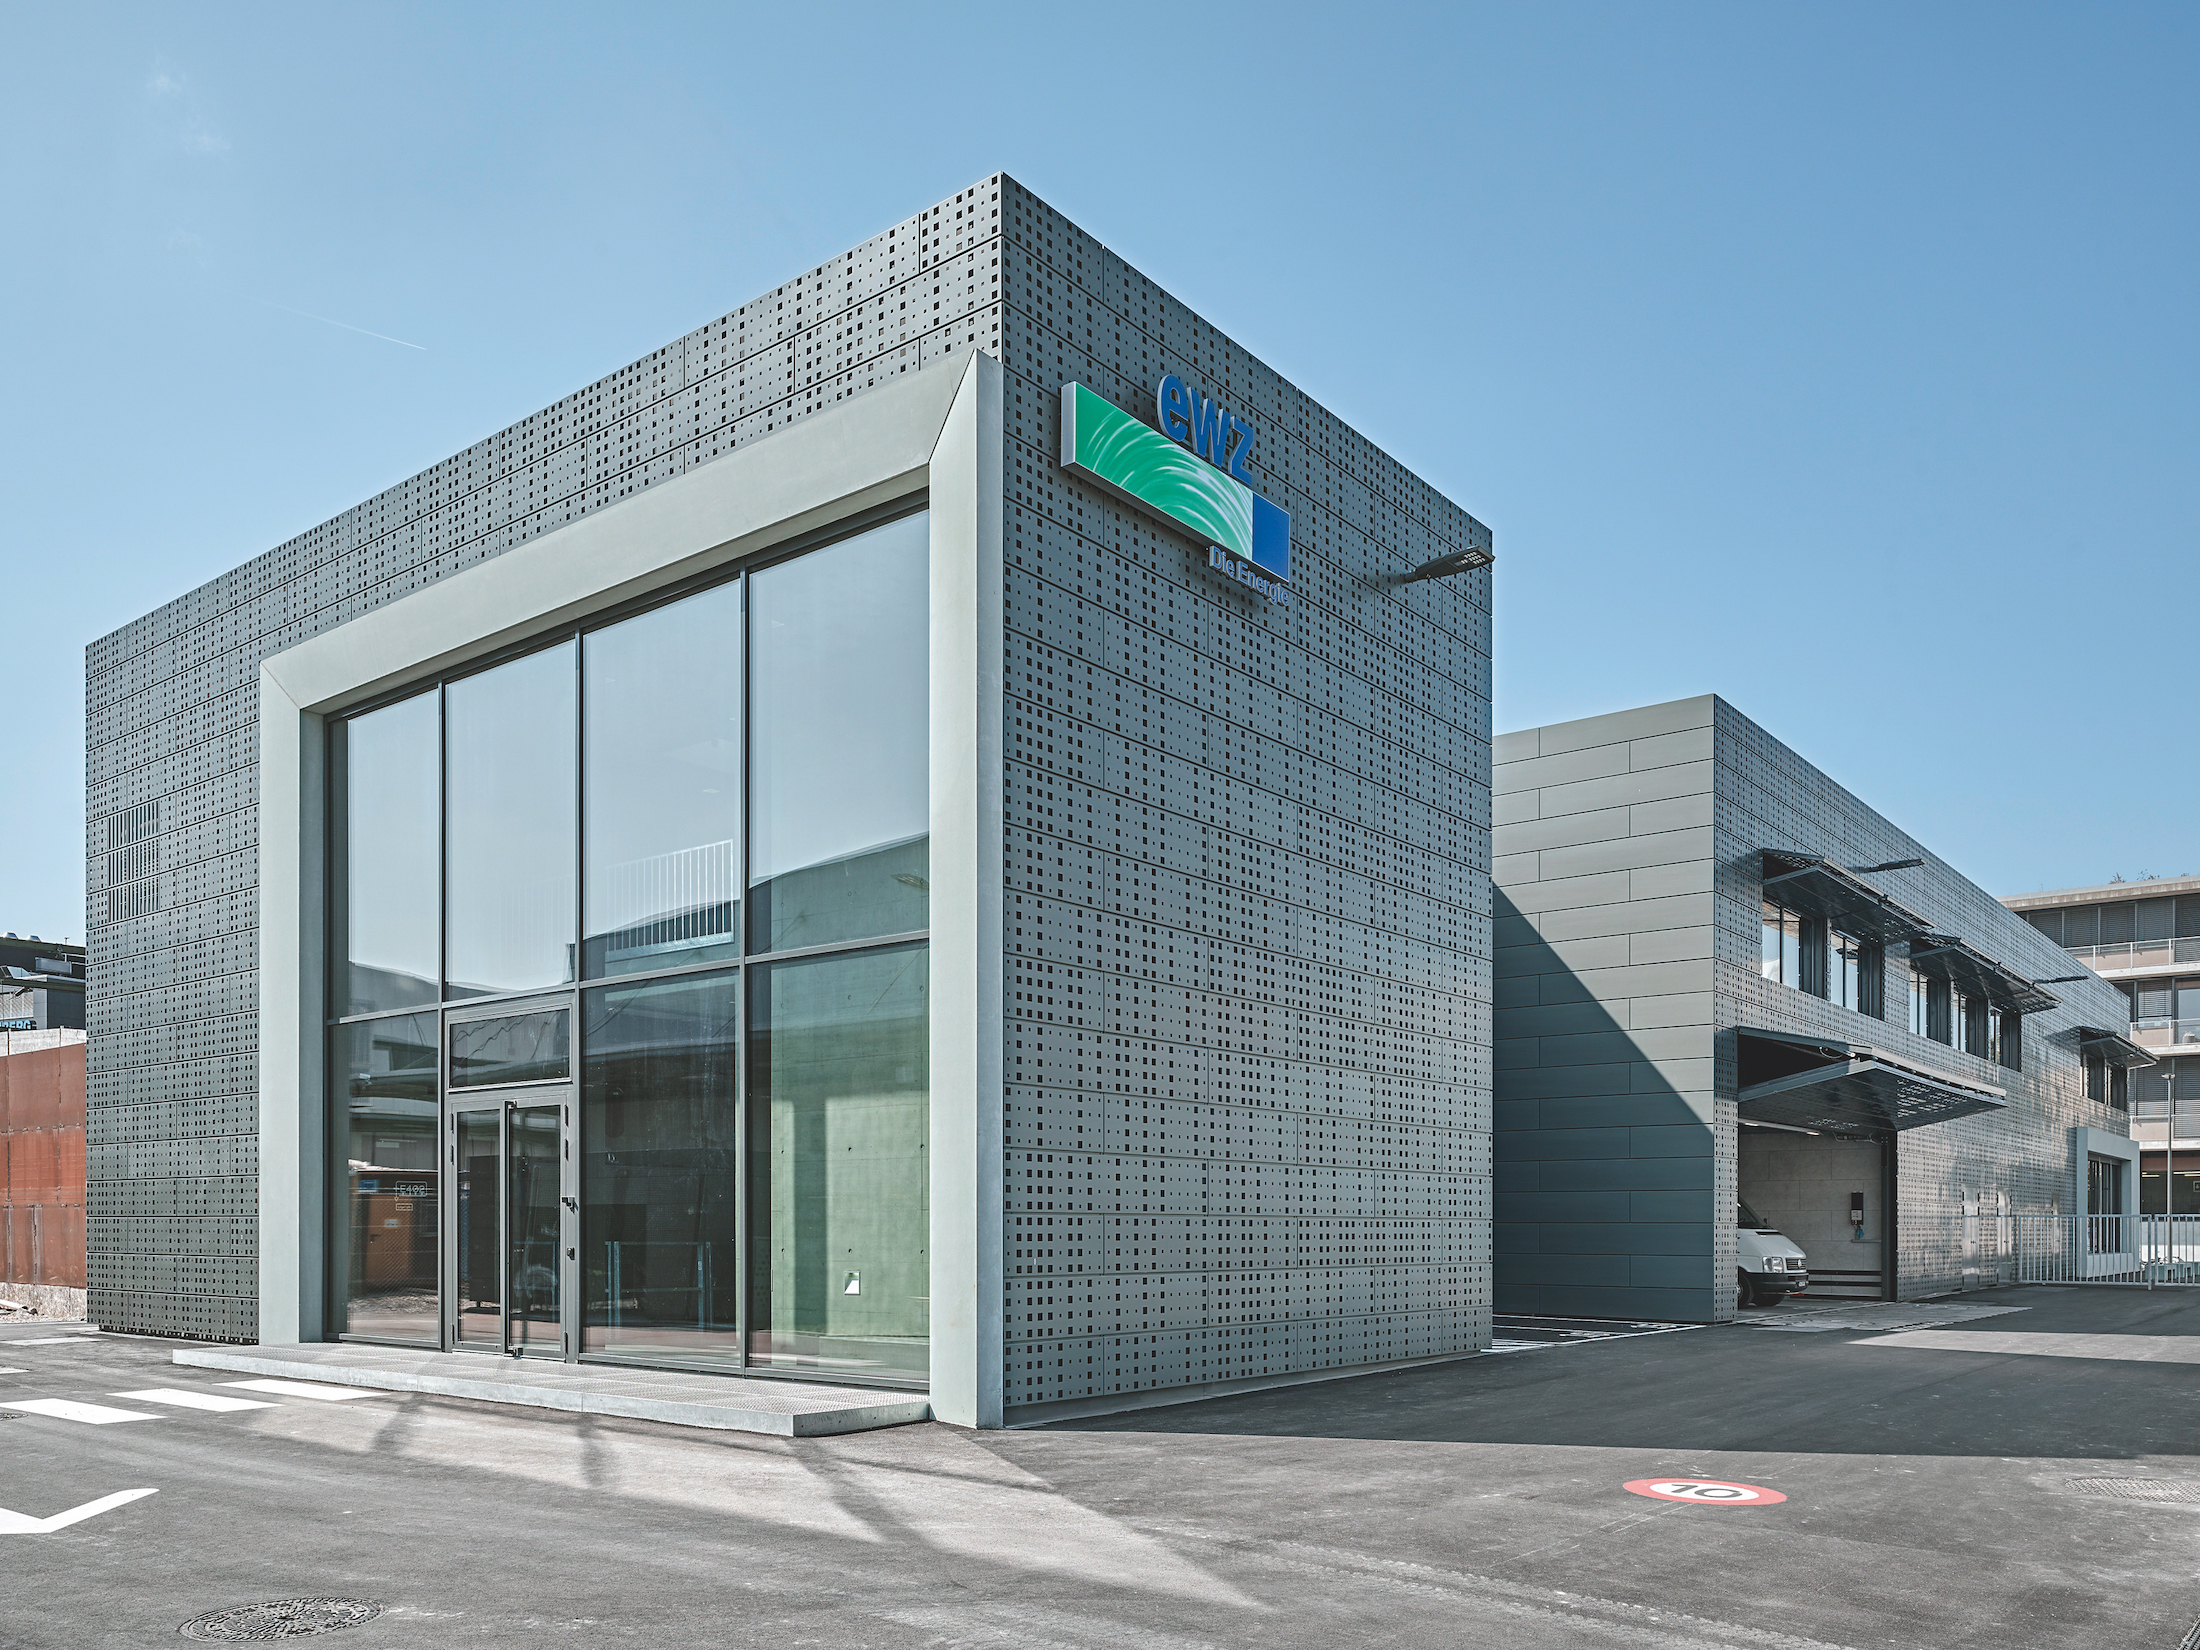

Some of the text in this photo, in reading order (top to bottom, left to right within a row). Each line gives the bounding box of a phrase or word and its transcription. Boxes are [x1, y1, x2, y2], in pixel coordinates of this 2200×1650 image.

[1157, 374, 1253, 486] ewz
[1209, 545, 1290, 607] Die Energie
[1671, 1484, 1743, 1498] 10
